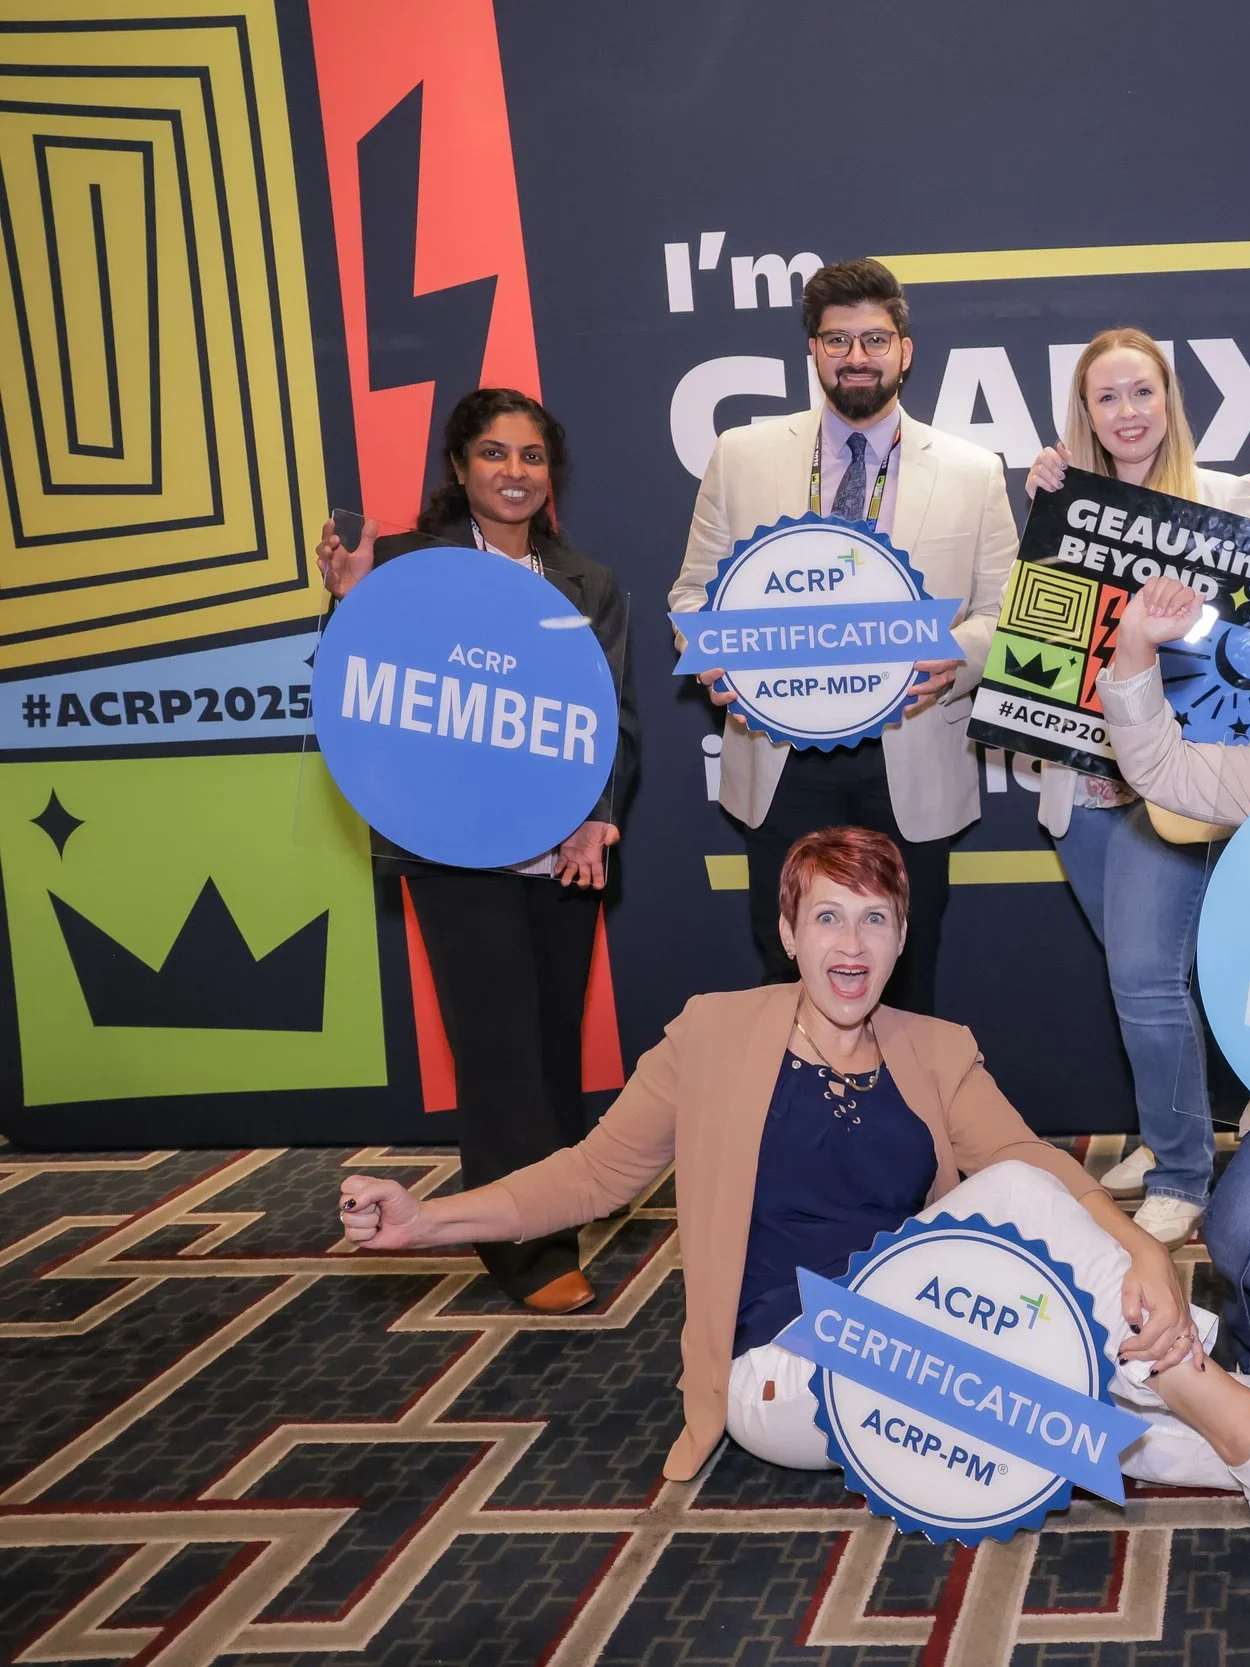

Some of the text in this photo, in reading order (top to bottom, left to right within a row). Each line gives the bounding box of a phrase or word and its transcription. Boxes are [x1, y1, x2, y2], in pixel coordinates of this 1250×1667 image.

[764, 568, 844, 595] ACRP
[447, 643, 518, 675] ACRP
[698, 618, 939, 656] CERTIFICATION
[21, 684, 314, 728] #ACRP2025
[341, 655, 598, 765] MEMBER
[915, 1275, 1020, 1336] ACRP
[813, 1309, 1108, 1464] CERTIFICATION
